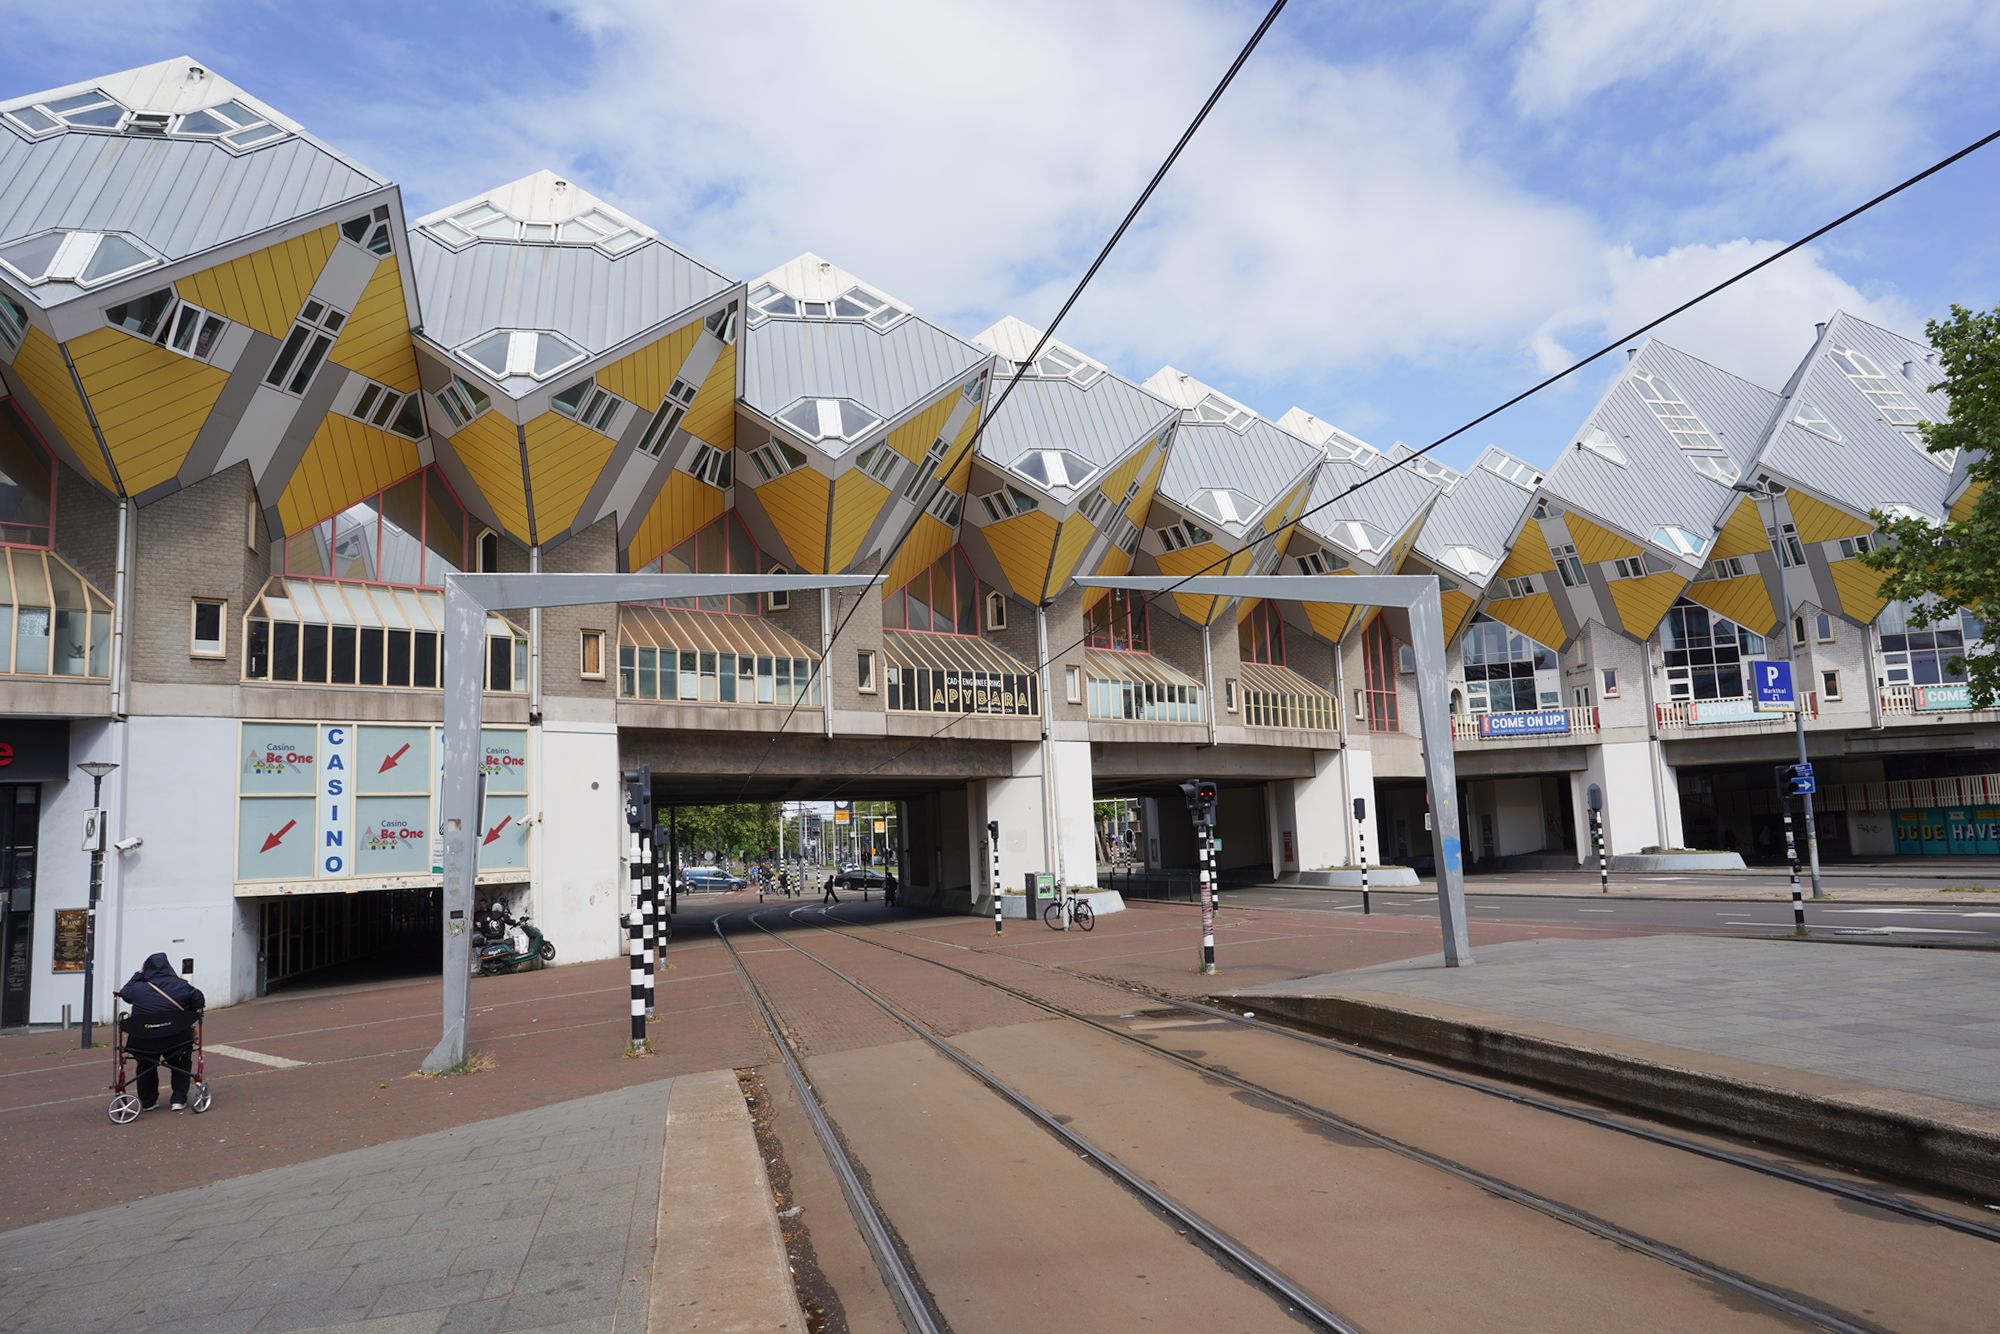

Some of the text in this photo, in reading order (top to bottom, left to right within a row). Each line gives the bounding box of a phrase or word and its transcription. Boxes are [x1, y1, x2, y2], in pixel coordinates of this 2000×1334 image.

[1766, 666, 1779, 687] P
[1927, 690, 1967, 702] COME
[1700, 704, 1736, 716] COME
[1491, 717, 1525, 729] COME
[1527, 716, 1543, 727] ON
[1545, 714, 1566, 726] UP!
[266, 743, 296, 752] Casino
[486, 746, 510, 755] Casino
[266, 752, 313, 764] Be One
[485, 755, 525, 766] Be One
[325, 728, 345, 873] CASINO
[381, 819, 408, 828] Casino
[380, 828, 424, 839] Be One
